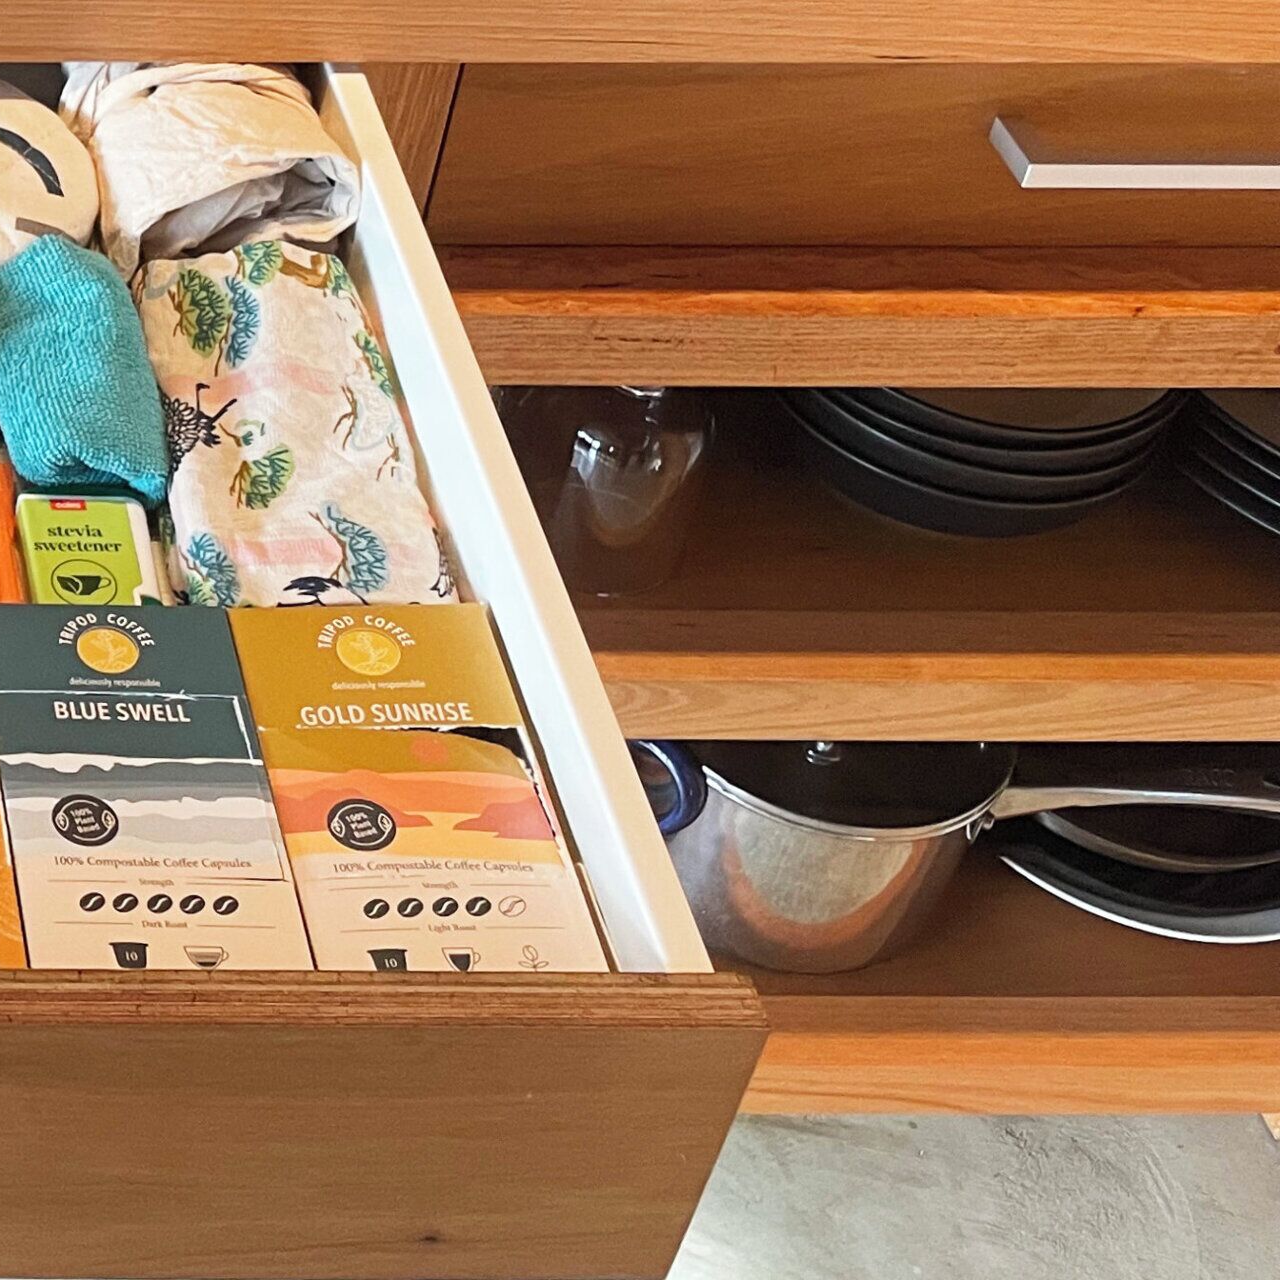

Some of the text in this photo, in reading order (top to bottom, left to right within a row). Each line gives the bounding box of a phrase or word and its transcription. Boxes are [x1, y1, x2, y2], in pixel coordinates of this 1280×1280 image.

[47, 525, 103, 537] stevia
[34, 541, 122, 552] sweetener
[58, 613, 155, 647] TRIPOD COFFEE
[318, 615, 416, 648] TRIPOD COFFEE
[69, 677, 161, 688] deliciously responsible
[332, 680, 425, 690] deliciously responsible
[53, 701, 191, 723] BLUE SWELL
[300, 703, 474, 726] GOLD SUNRISE
[53, 856, 252, 870] 100% Compostable Coffee Capsules
[333, 861, 533, 874] 100% Compostable Coffee Capsules
[139, 878, 175, 887] Strength
[421, 881, 459, 890] Strength
[141, 920, 163, 928] Dark
[428, 924, 451, 933] Light
[125, 951, 138, 961] 10
[384, 958, 398, 968] 10
